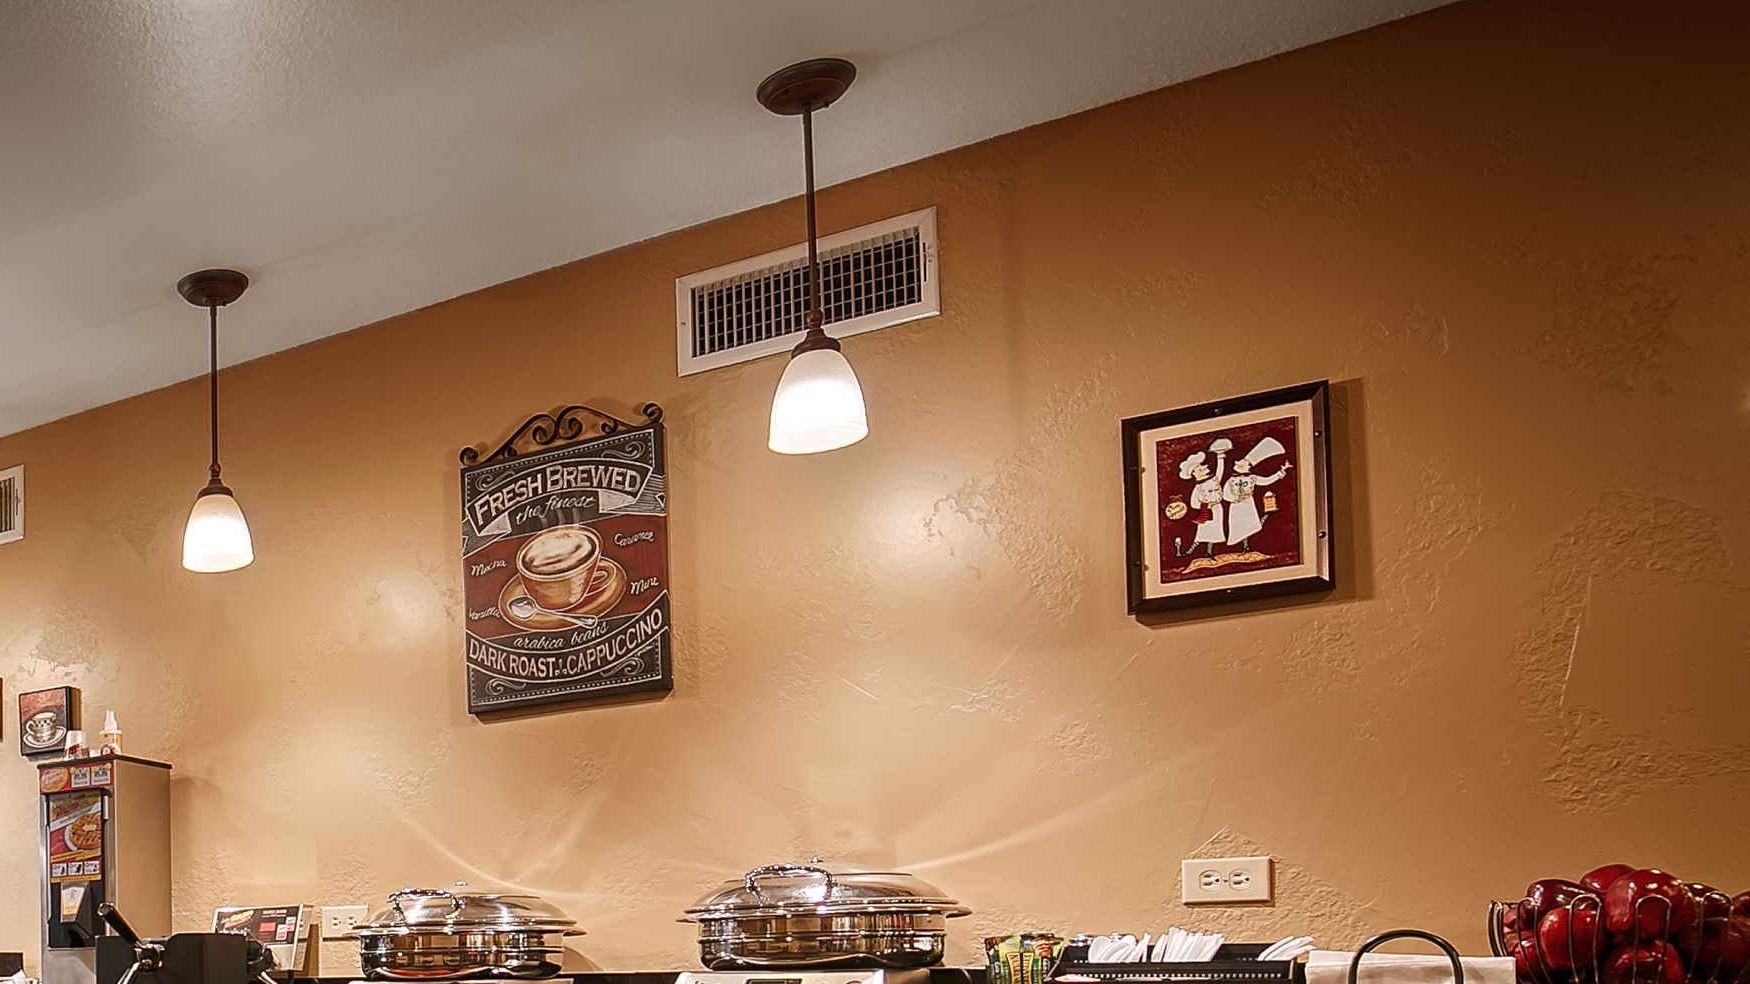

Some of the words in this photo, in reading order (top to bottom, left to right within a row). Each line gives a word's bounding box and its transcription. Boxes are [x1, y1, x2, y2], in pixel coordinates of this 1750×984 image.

[473, 473, 543, 527] FRESH
[545, 464, 642, 494] BREWED
[515, 504, 542, 525] the
[540, 494, 597, 519] finest
[629, 576, 660, 595] Mint
[469, 638, 508, 673] DARK
[508, 654, 557, 678] ROAST
[566, 607, 663, 676] CAPPUCCINO
[513, 634, 566, 650] arabica
[570, 620, 609, 646] beans
